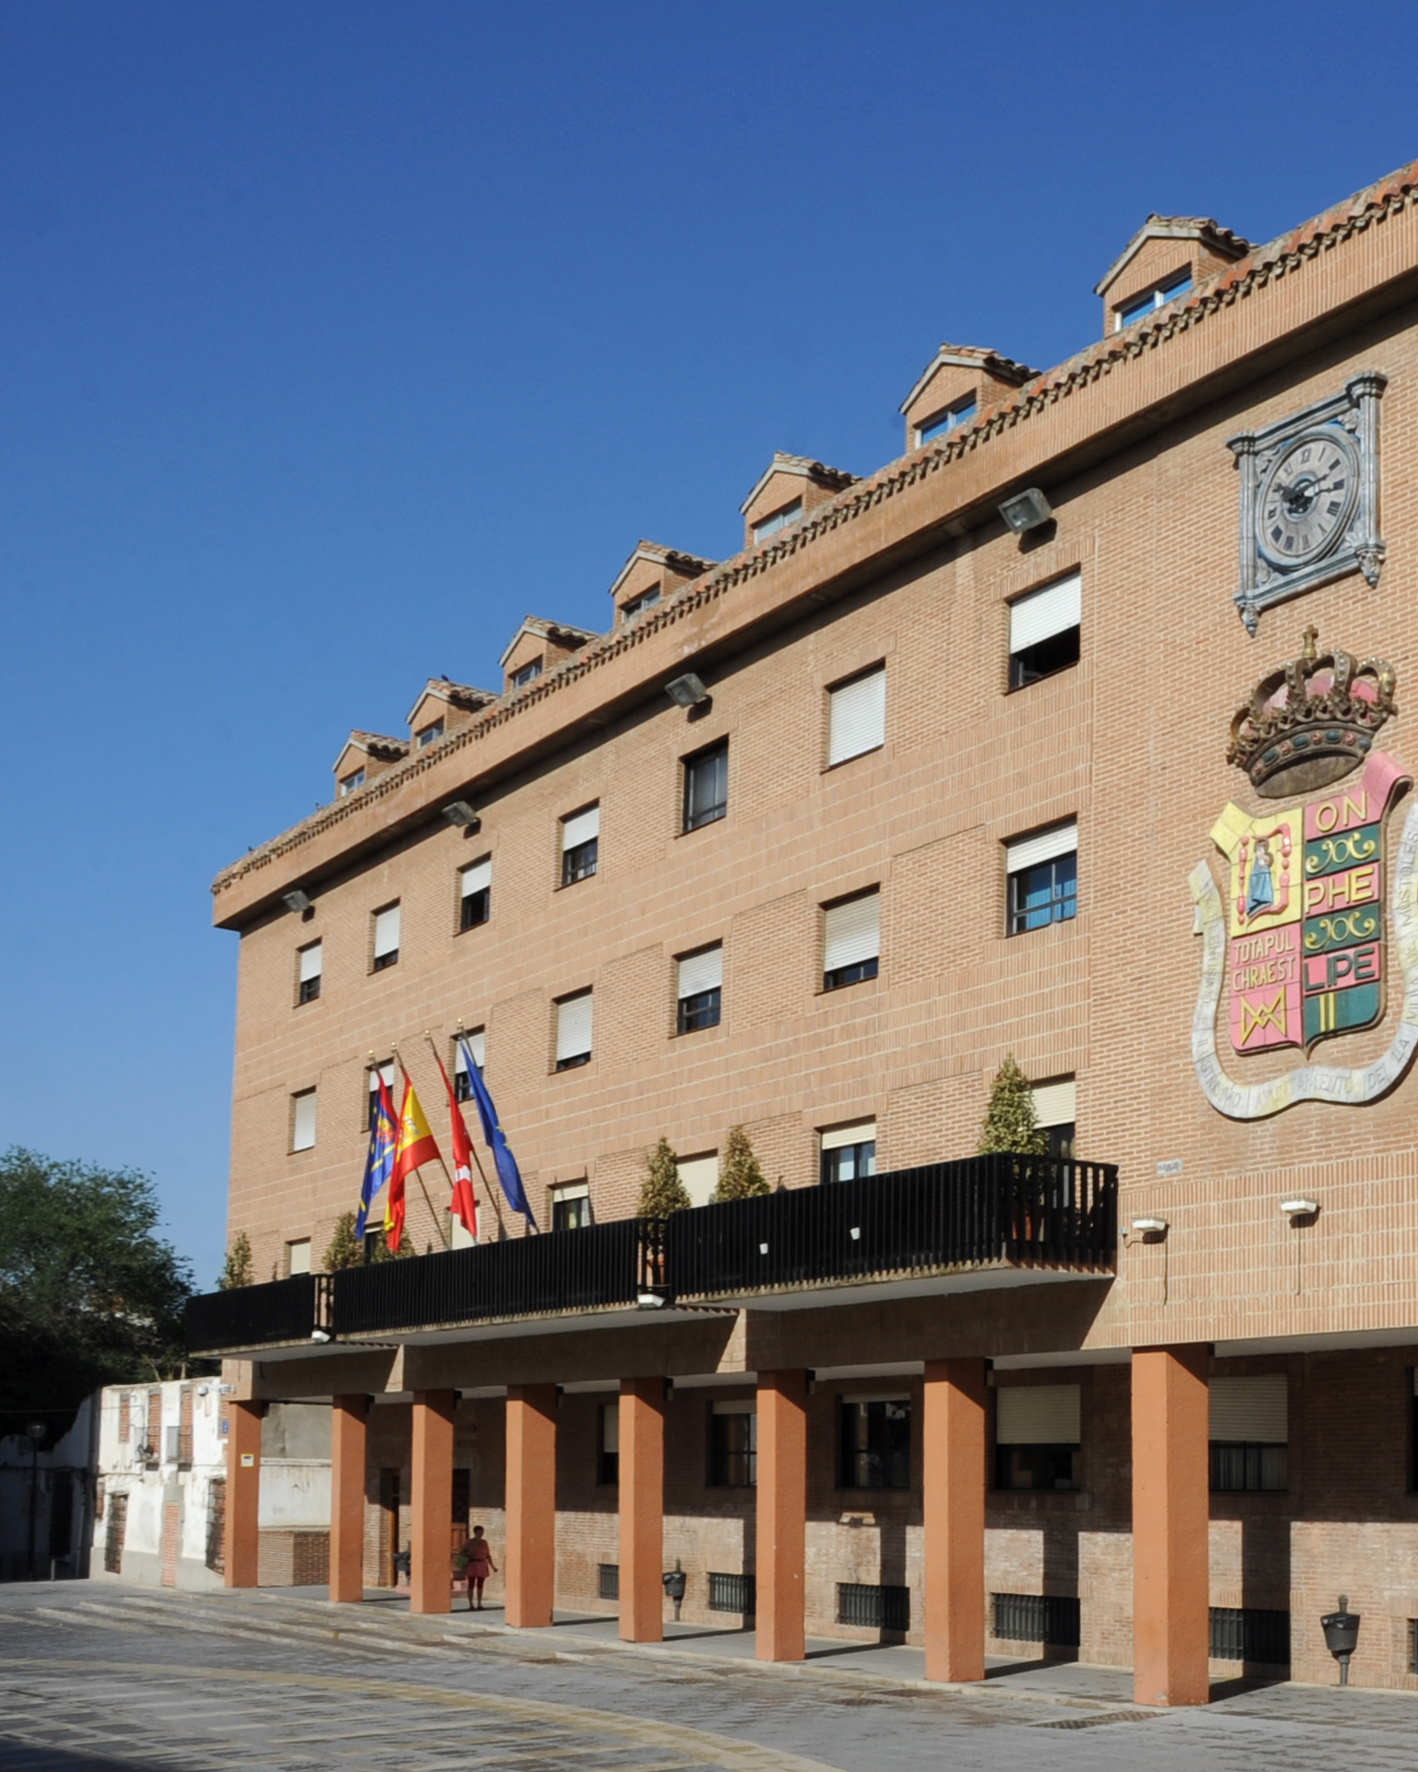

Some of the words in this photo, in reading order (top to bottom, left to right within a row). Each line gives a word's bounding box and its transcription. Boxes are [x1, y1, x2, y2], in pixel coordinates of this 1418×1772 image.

[1315, 790, 1367, 832] ON
[1304, 866, 1374, 914] PHE
[1233, 929, 1296, 966] TOTAPUL
[1232, 956, 1296, 993] CHRAEST
[1304, 947, 1375, 993] LIPE
